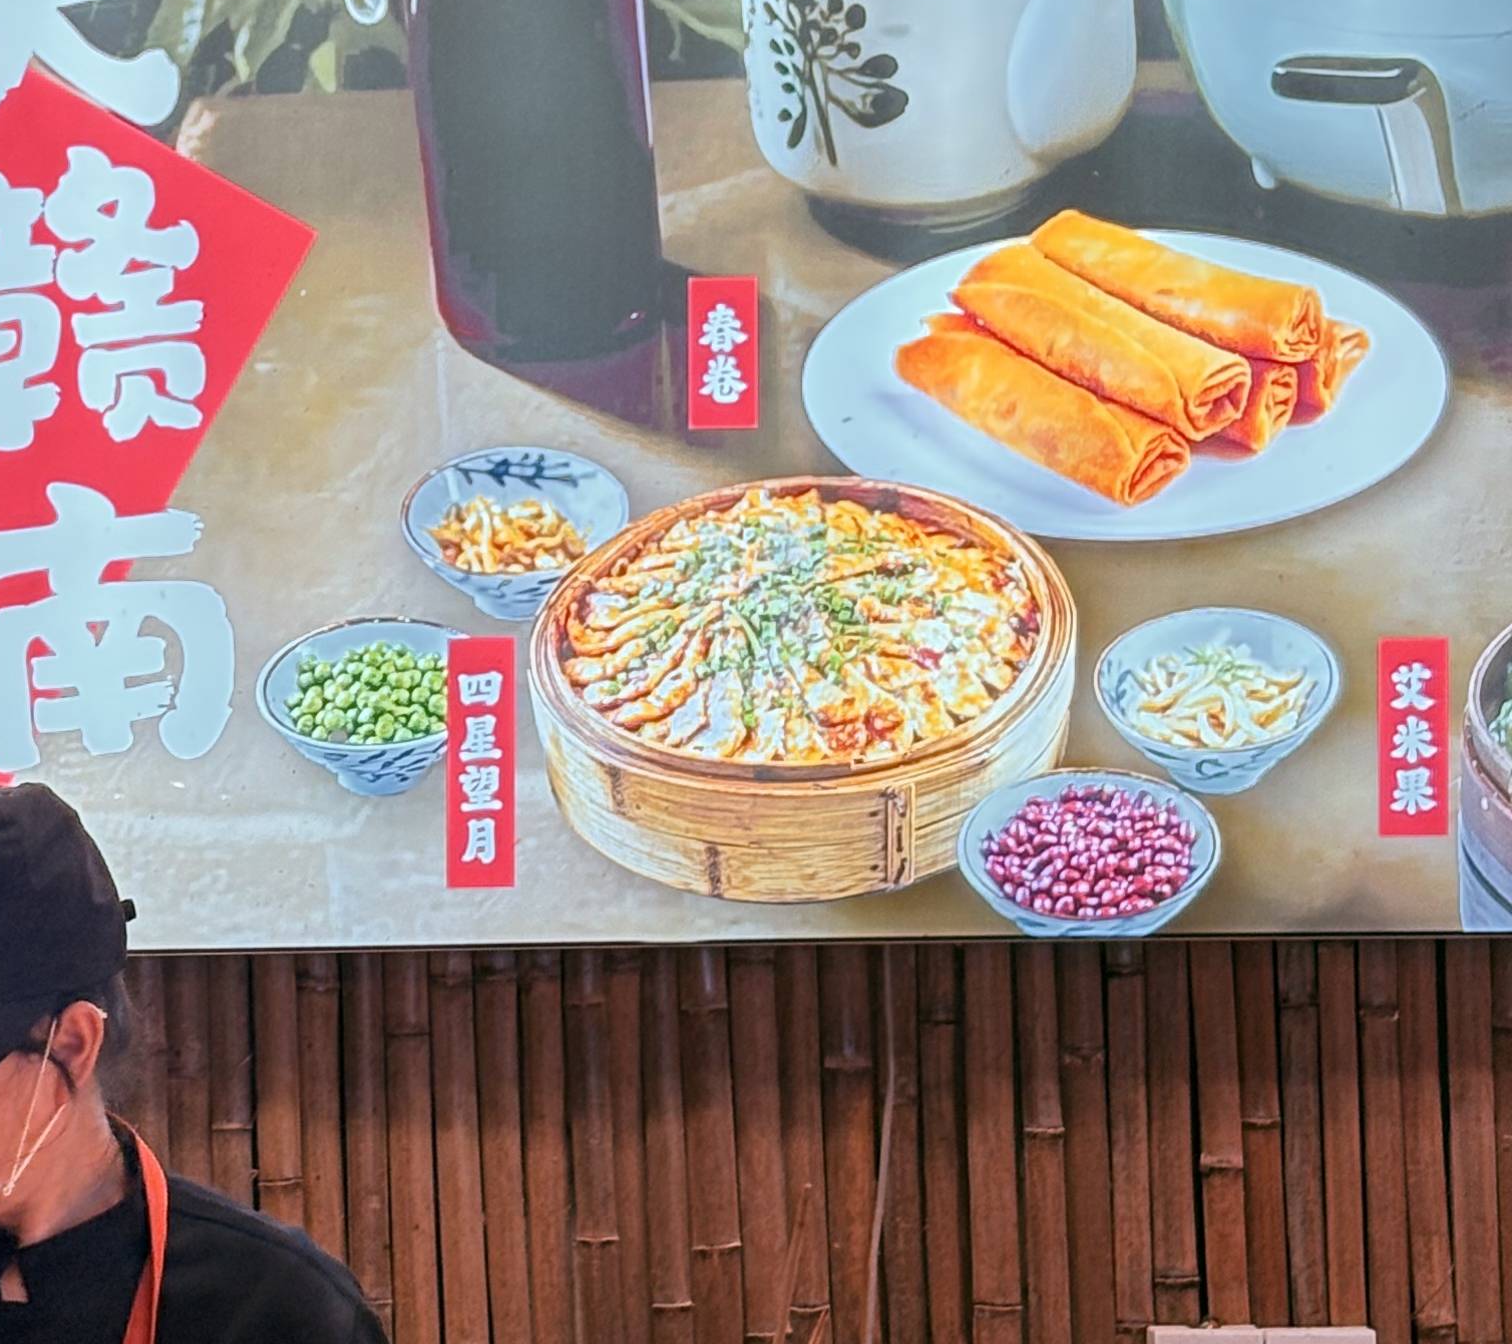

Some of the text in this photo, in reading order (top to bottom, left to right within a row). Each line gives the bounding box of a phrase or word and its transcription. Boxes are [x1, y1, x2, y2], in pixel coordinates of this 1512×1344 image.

[698, 303, 749, 405] 春卷
[457, 670, 504, 865] 四星望月
[1390, 661, 1438, 815] 艾米果
